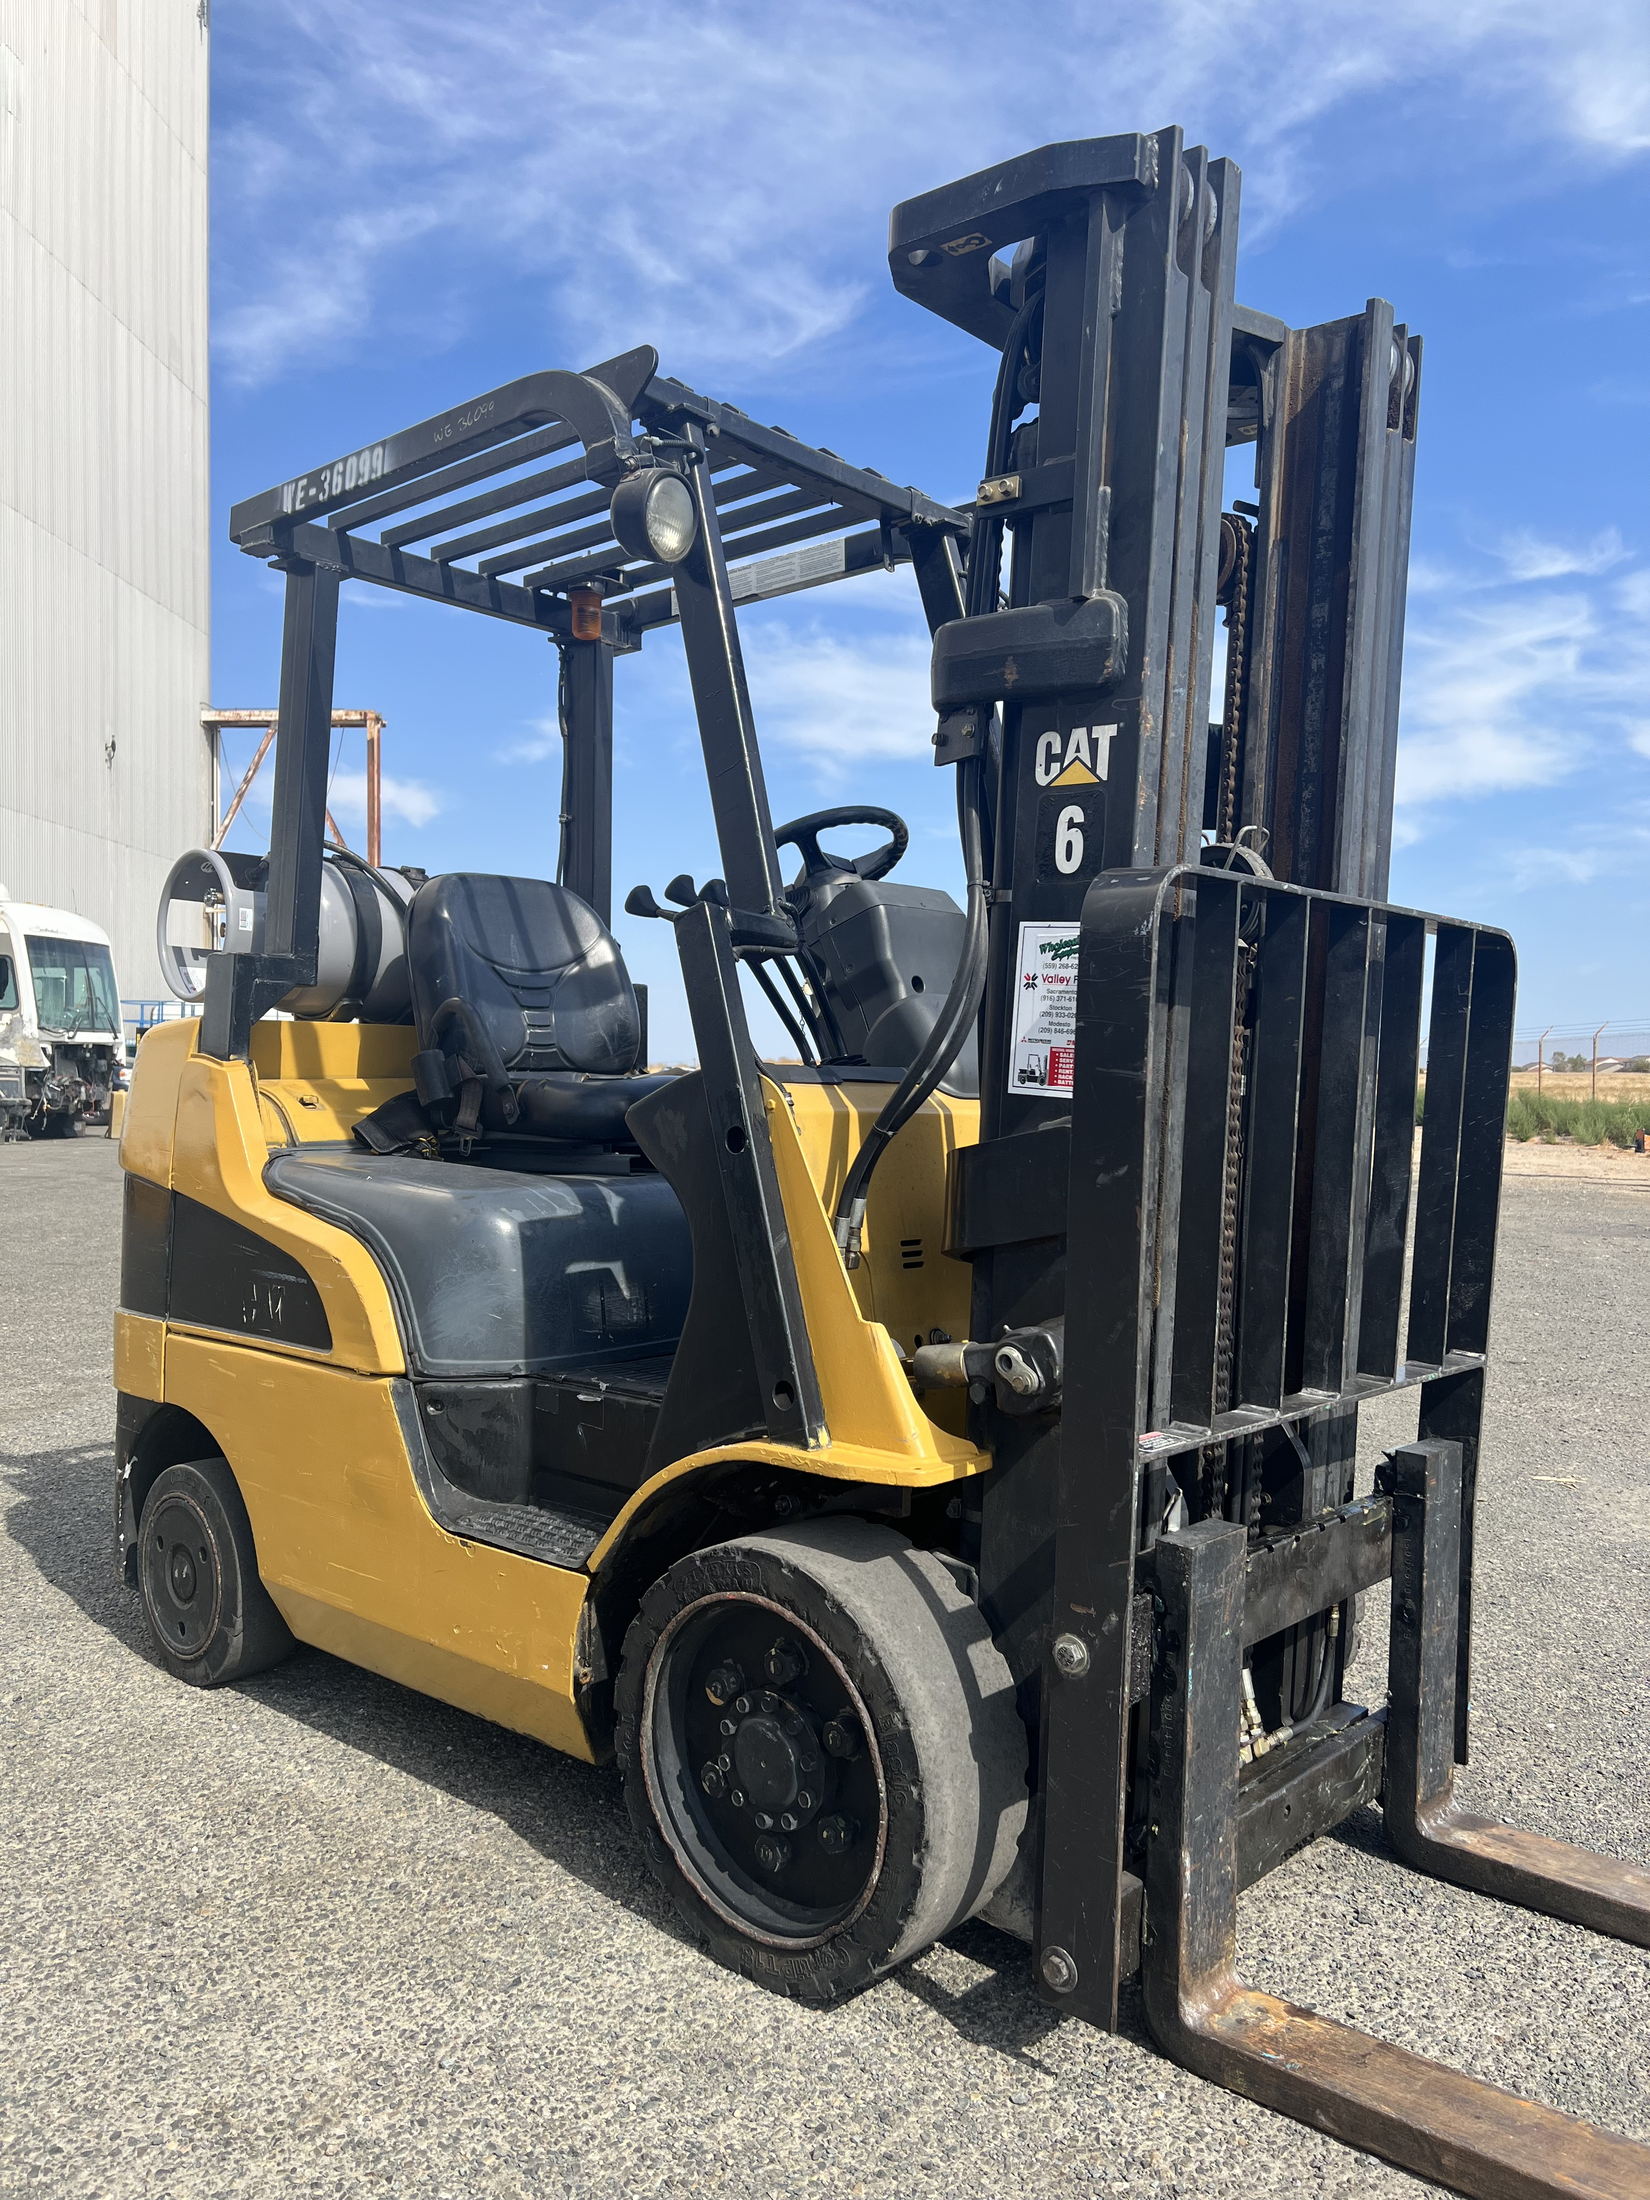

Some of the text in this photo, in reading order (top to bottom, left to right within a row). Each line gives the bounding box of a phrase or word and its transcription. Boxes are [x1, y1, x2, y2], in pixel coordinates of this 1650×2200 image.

[433, 423, 453, 443] WE
[282, 445, 384, 514] WE-36099
[1035, 724, 1118, 787] CAT
[1055, 804, 1085, 875] 6
[1042, 974, 1072, 986] Valley
[1039, 1011, 1055, 1019] (209)
[1038, 1027, 1053, 1035] (209)
[1048, 1020, 1071, 1028] Modesto
